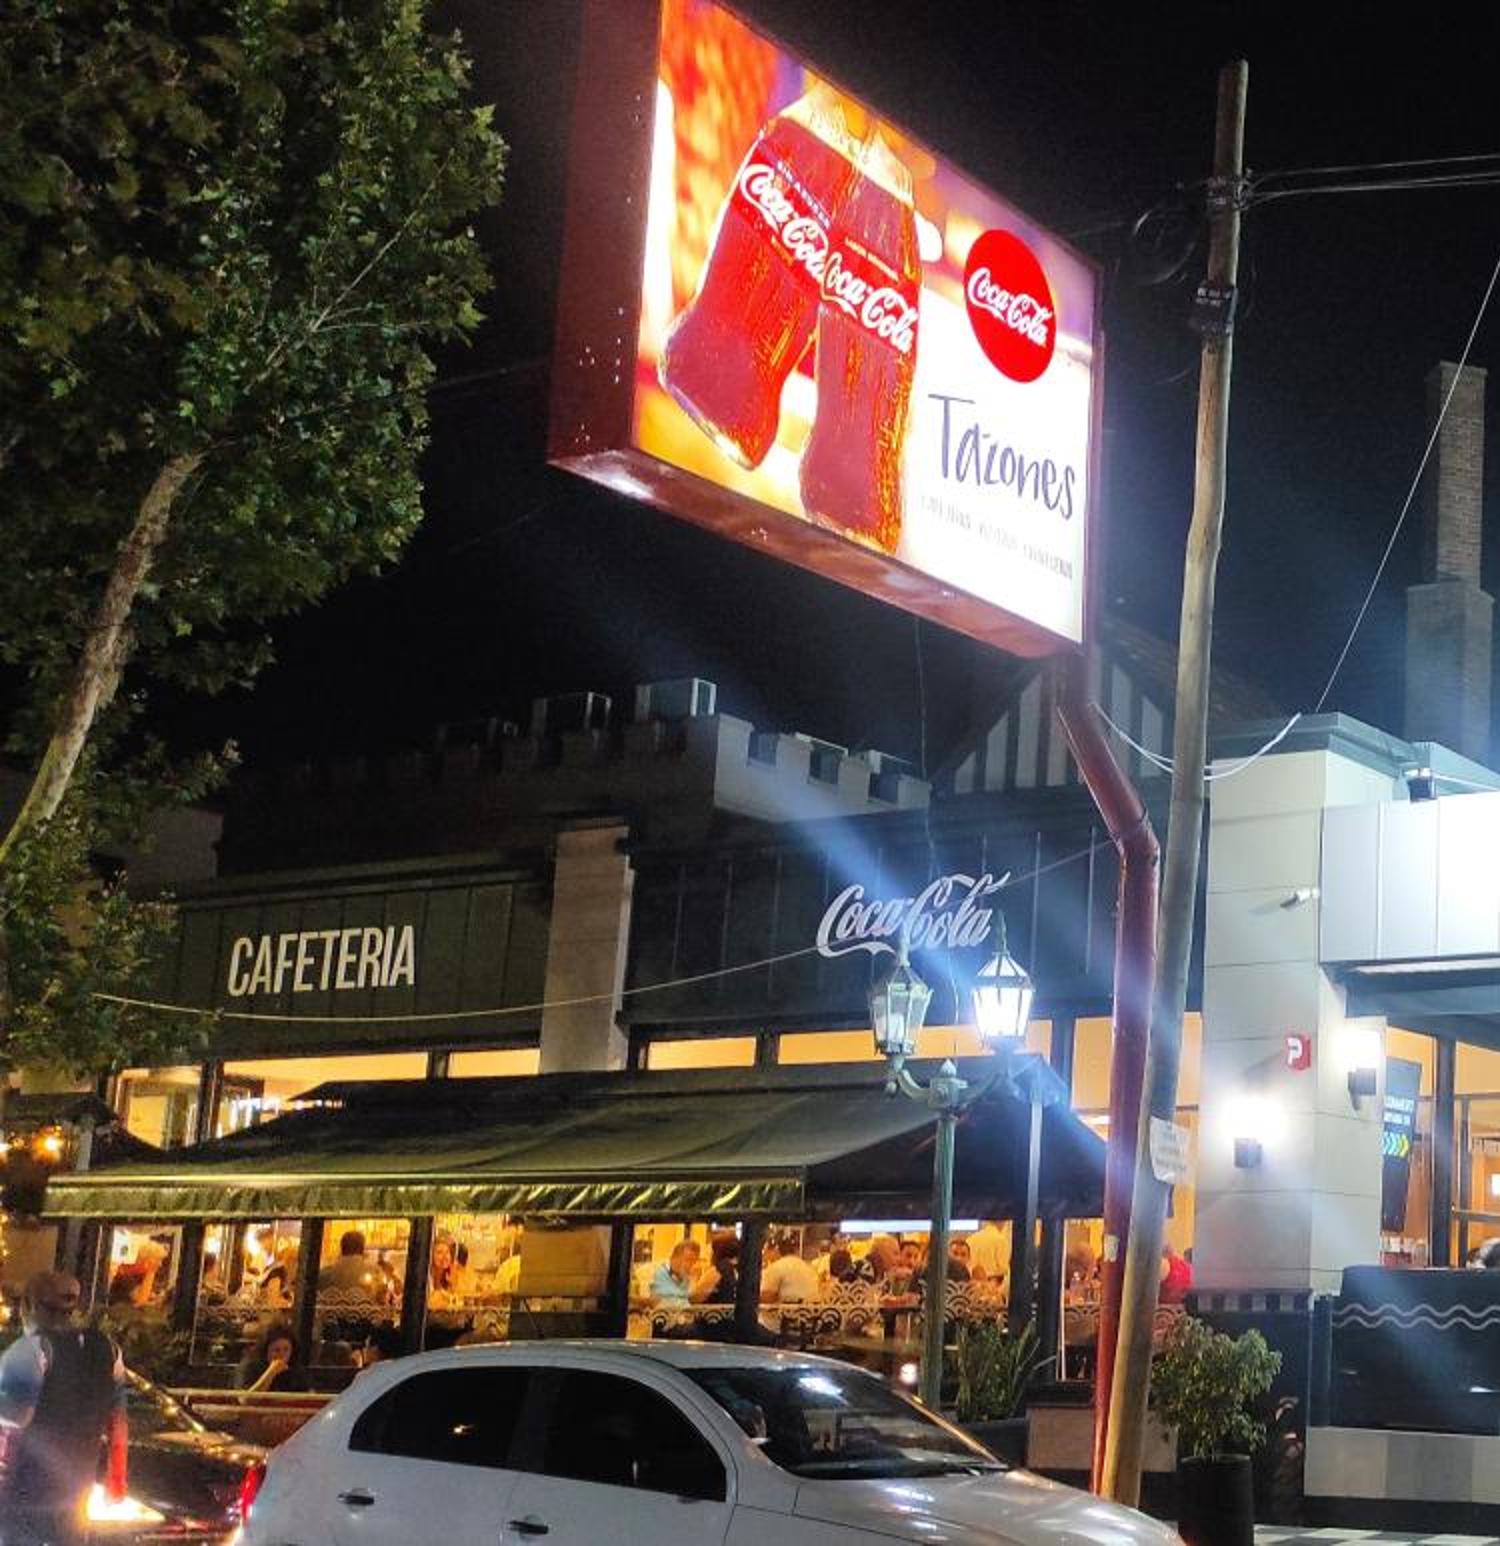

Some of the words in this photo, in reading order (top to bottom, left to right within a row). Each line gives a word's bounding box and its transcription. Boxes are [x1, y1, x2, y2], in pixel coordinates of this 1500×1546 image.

[820, 252, 918, 354] Coca-Cola
[967, 266, 1052, 349] Coca-Cola
[928, 394, 1075, 520] Tazones
[816, 871, 1011, 957] Coca-Cola
[227, 925, 415, 997] CAFETERIA
